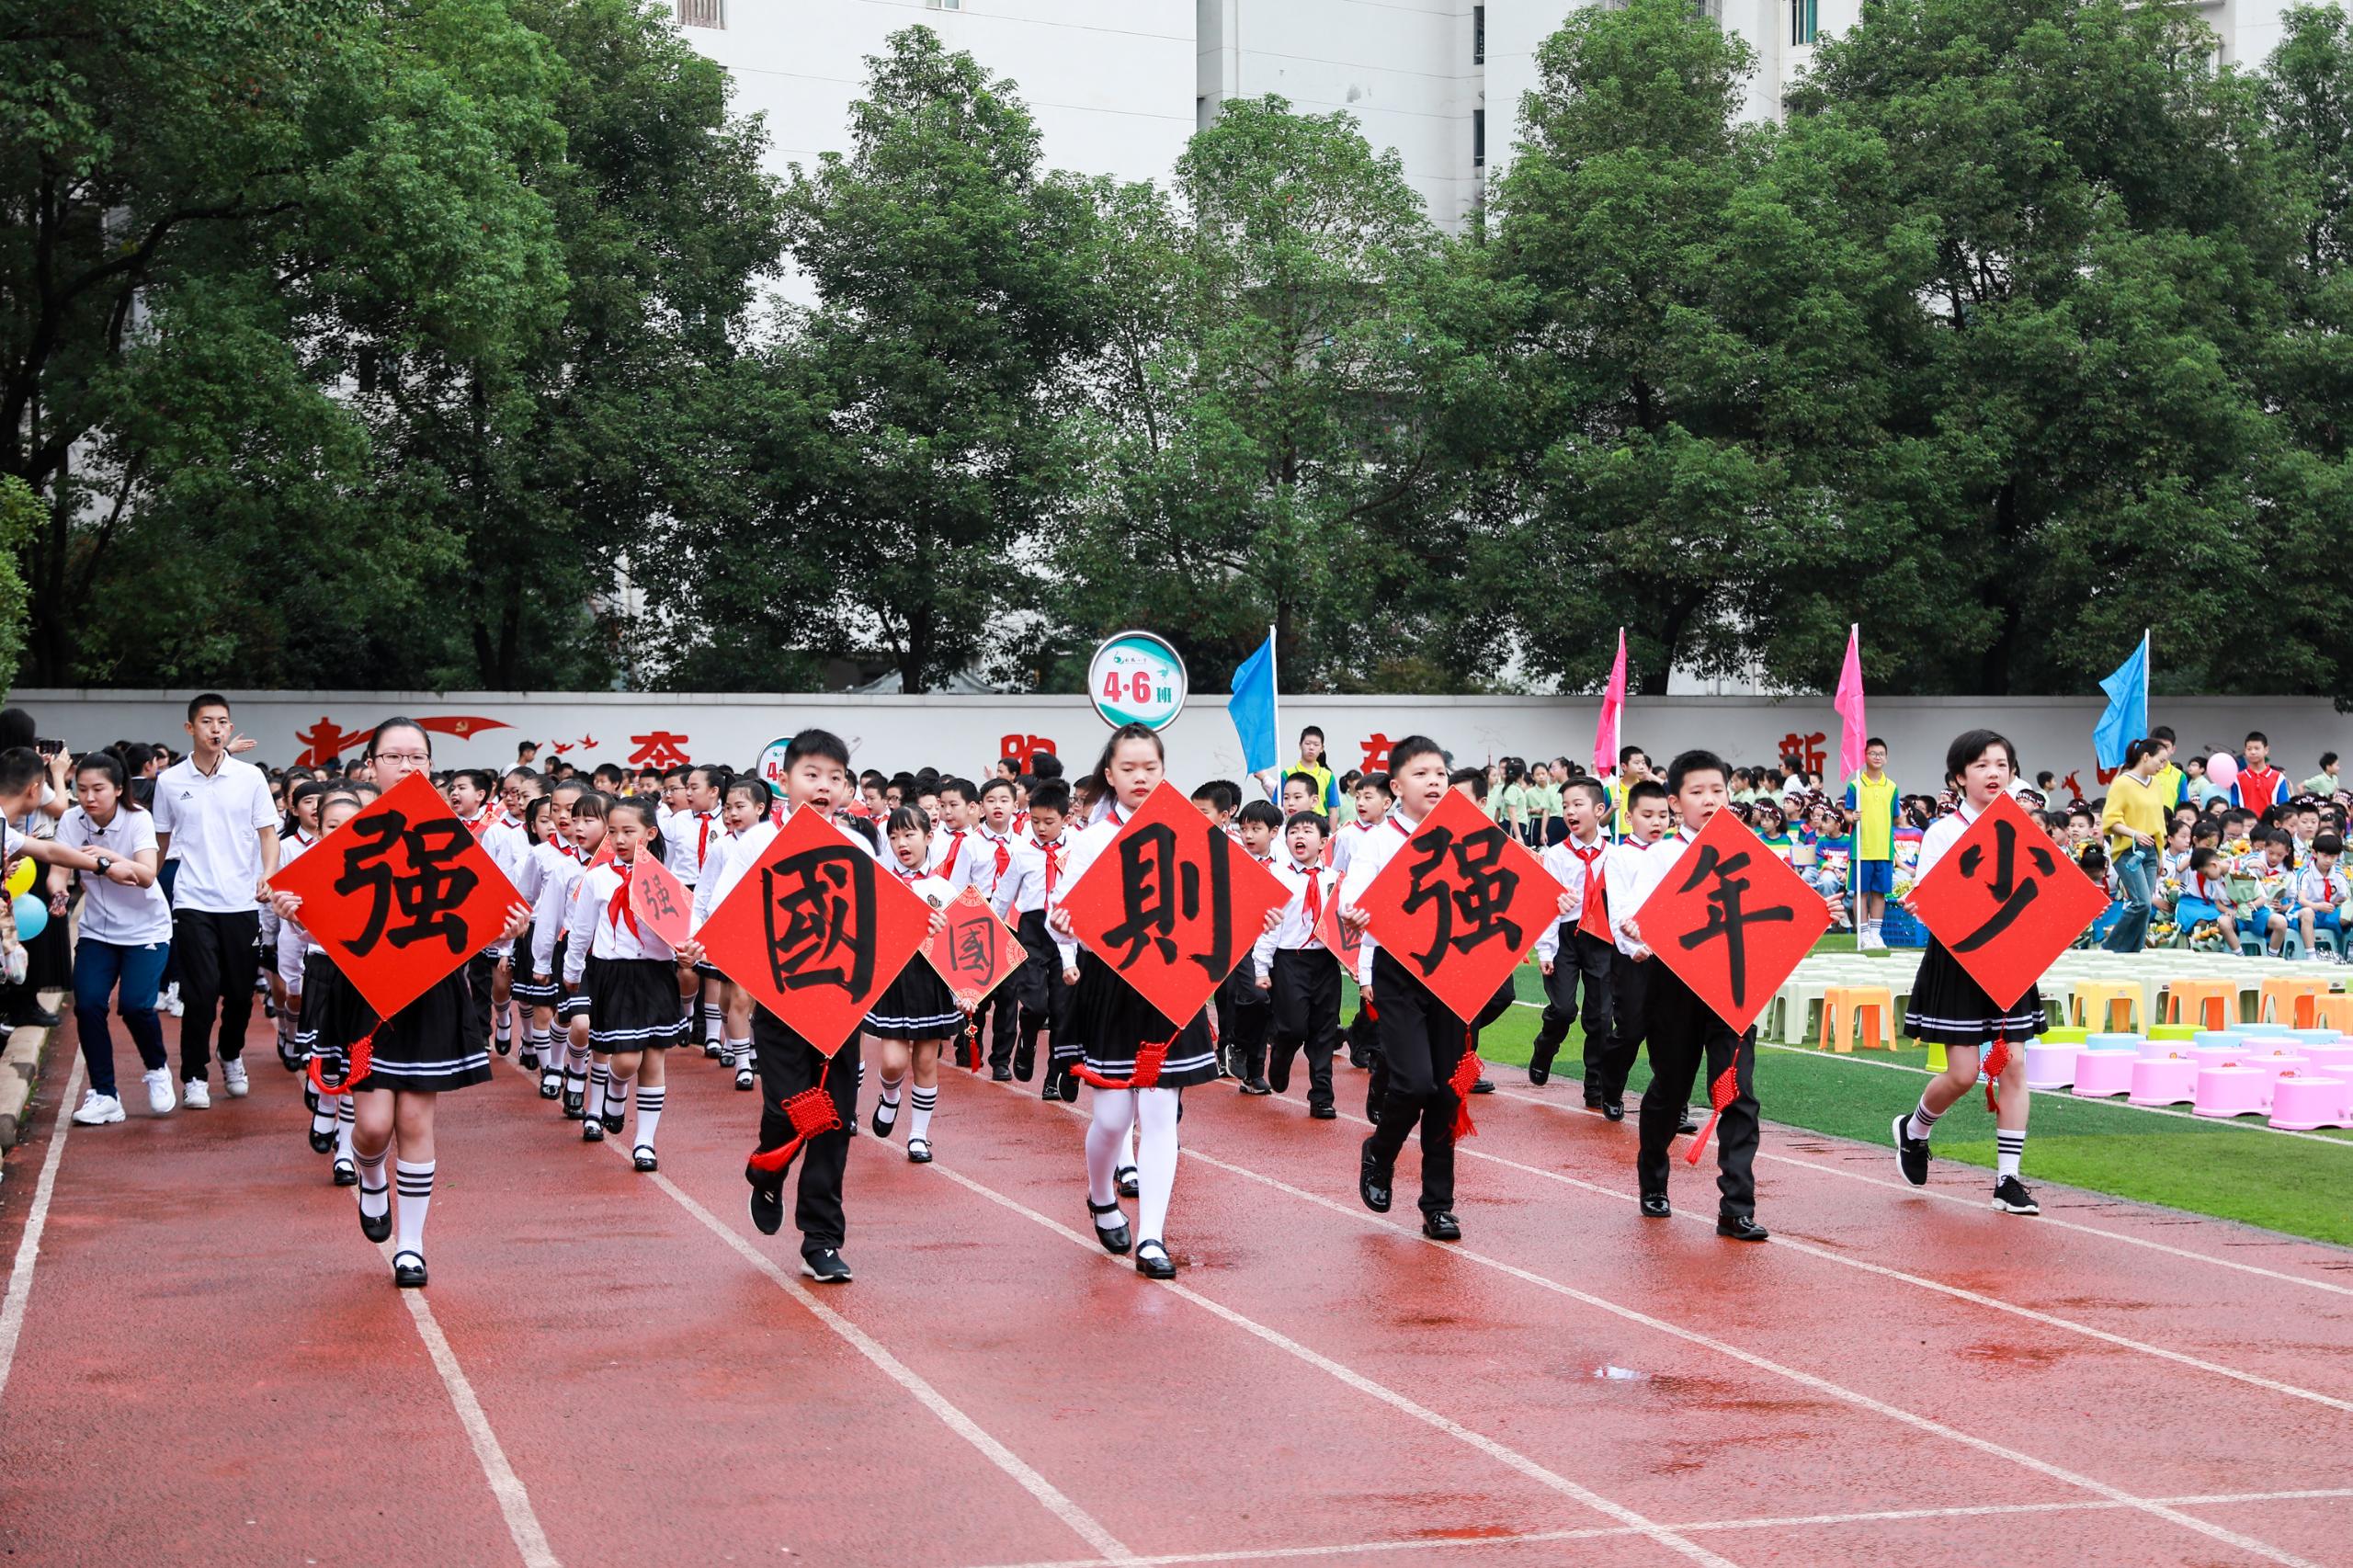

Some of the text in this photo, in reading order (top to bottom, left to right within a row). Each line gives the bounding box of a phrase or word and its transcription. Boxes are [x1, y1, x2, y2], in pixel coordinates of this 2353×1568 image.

[335, 810, 478, 956] 强
[762, 846, 877, 1004] 國
[949, 917, 995, 986] 國
[1102, 823, 1232, 982] 則
[1403, 825, 1522, 976] 强
[1677, 845, 1794, 1007] 年
[1951, 819, 2056, 953] 少
